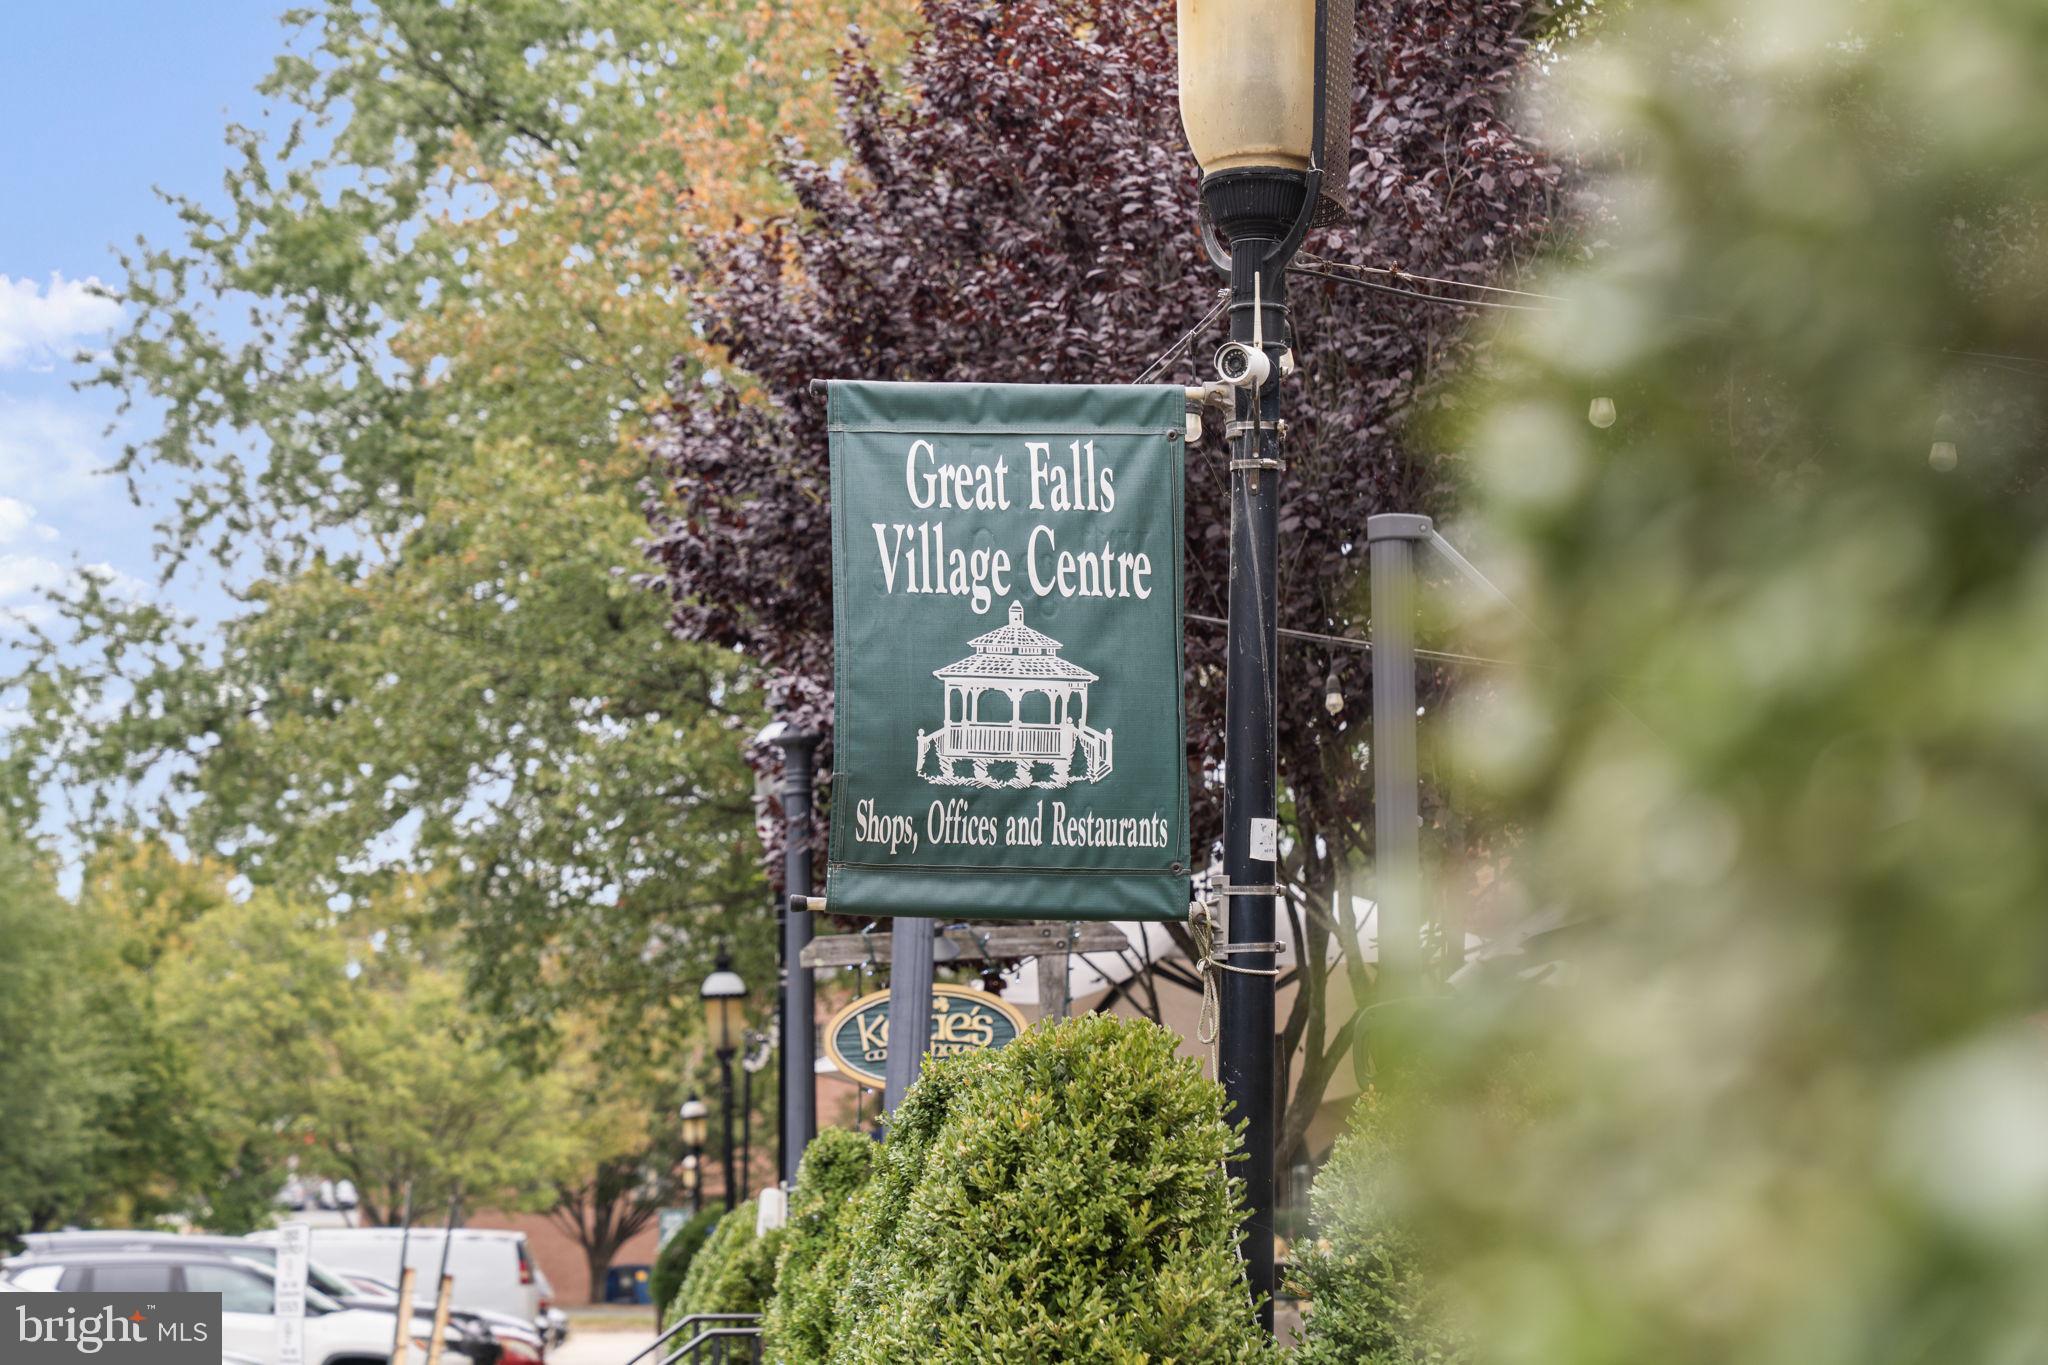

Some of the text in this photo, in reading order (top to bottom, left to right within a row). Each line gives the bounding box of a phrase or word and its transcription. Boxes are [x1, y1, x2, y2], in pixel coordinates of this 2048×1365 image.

[906, 439, 1115, 513] Great Falls
[872, 521, 1152, 614] Village Centre
[855, 798, 1168, 854] Shops, Offices and Restaurants
[857, 1005, 994, 1051] Kie's
